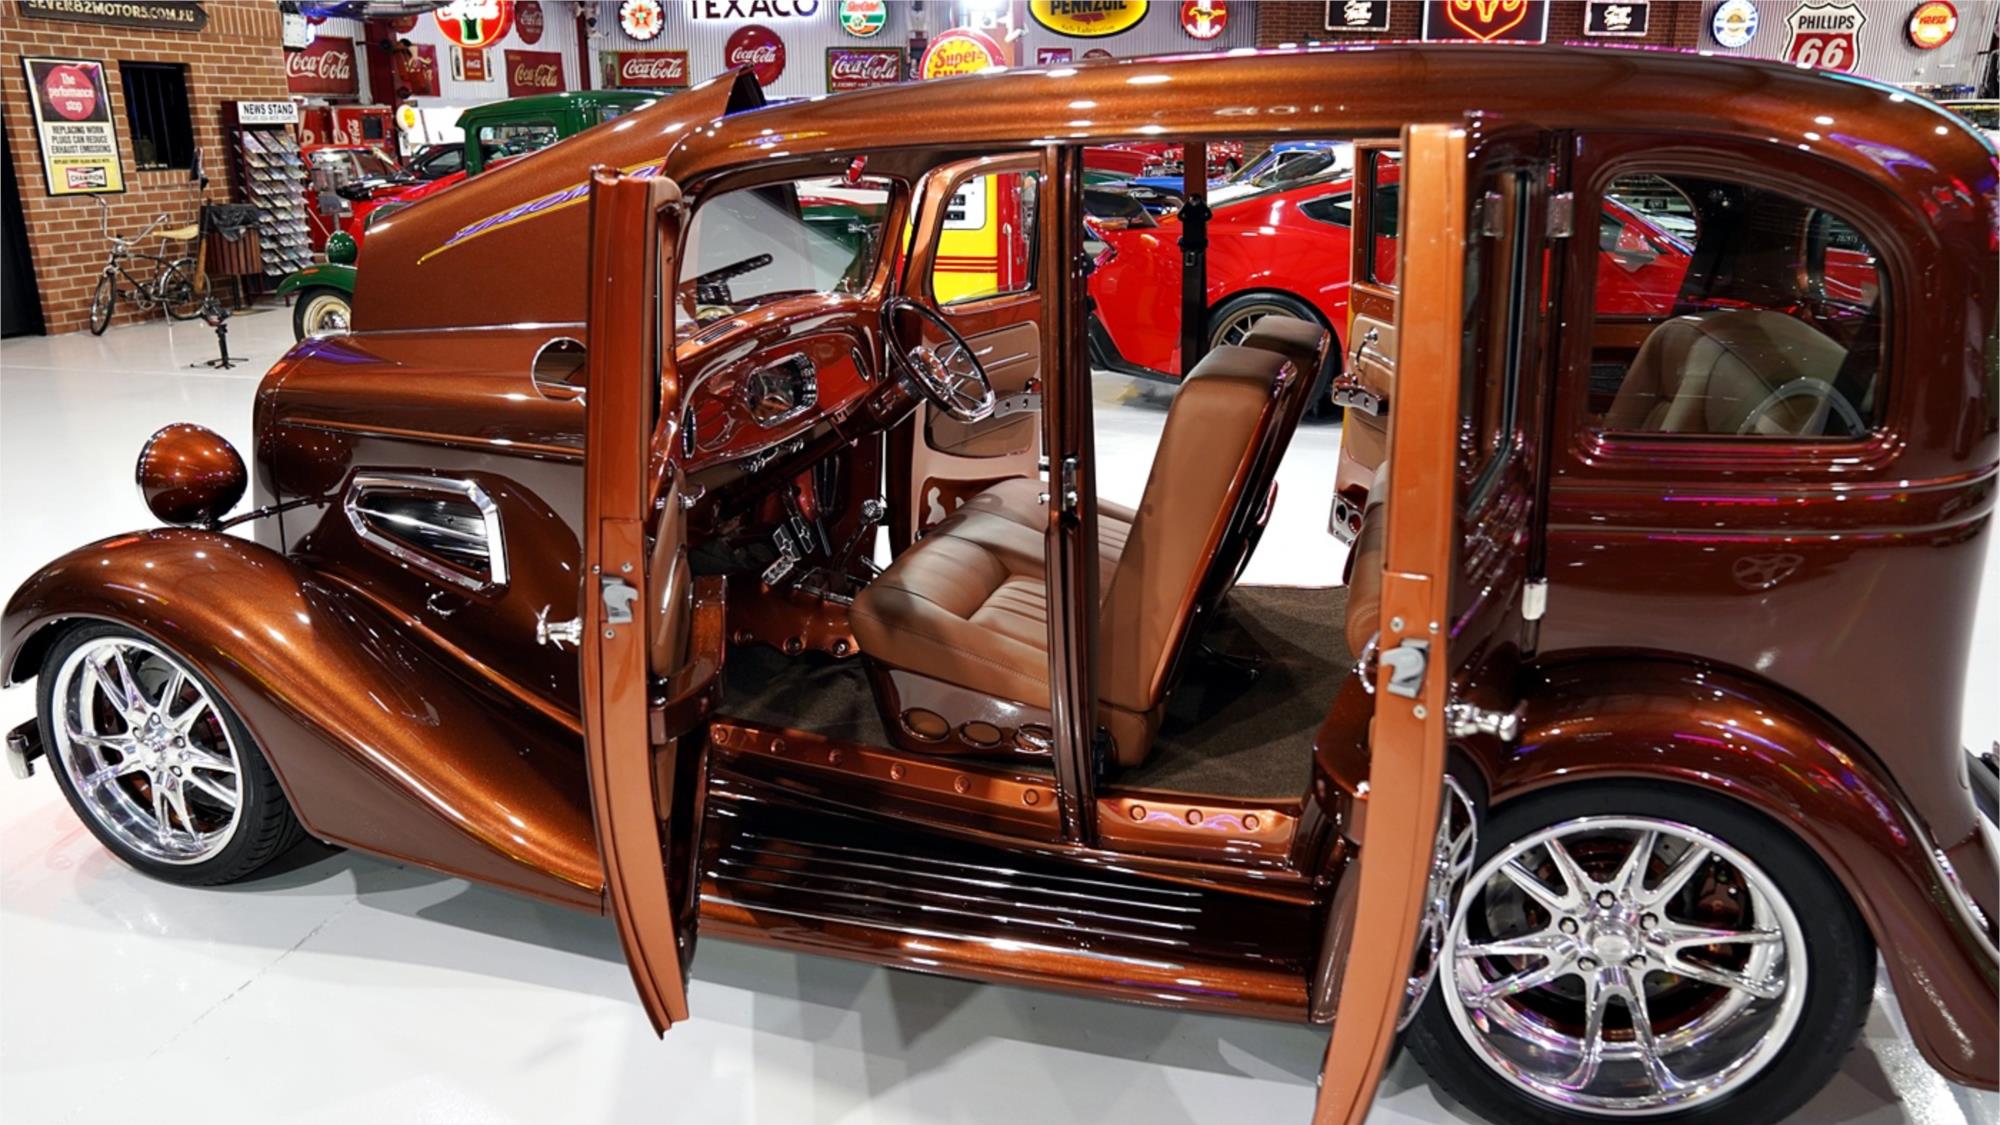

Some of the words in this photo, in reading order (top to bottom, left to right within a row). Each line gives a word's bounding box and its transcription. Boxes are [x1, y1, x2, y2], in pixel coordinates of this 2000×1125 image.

[1798, 15, 1856, 30] PHILLIPS
[286, 51, 351, 79] Coca-Cola
[1796, 37, 1848, 70] 66
[622, 57, 683, 80] Coca-Cola
[832, 54, 899, 80] Coca-Cola
[243, 104, 266, 115] NEWS
[268, 104, 294, 115] STAND
